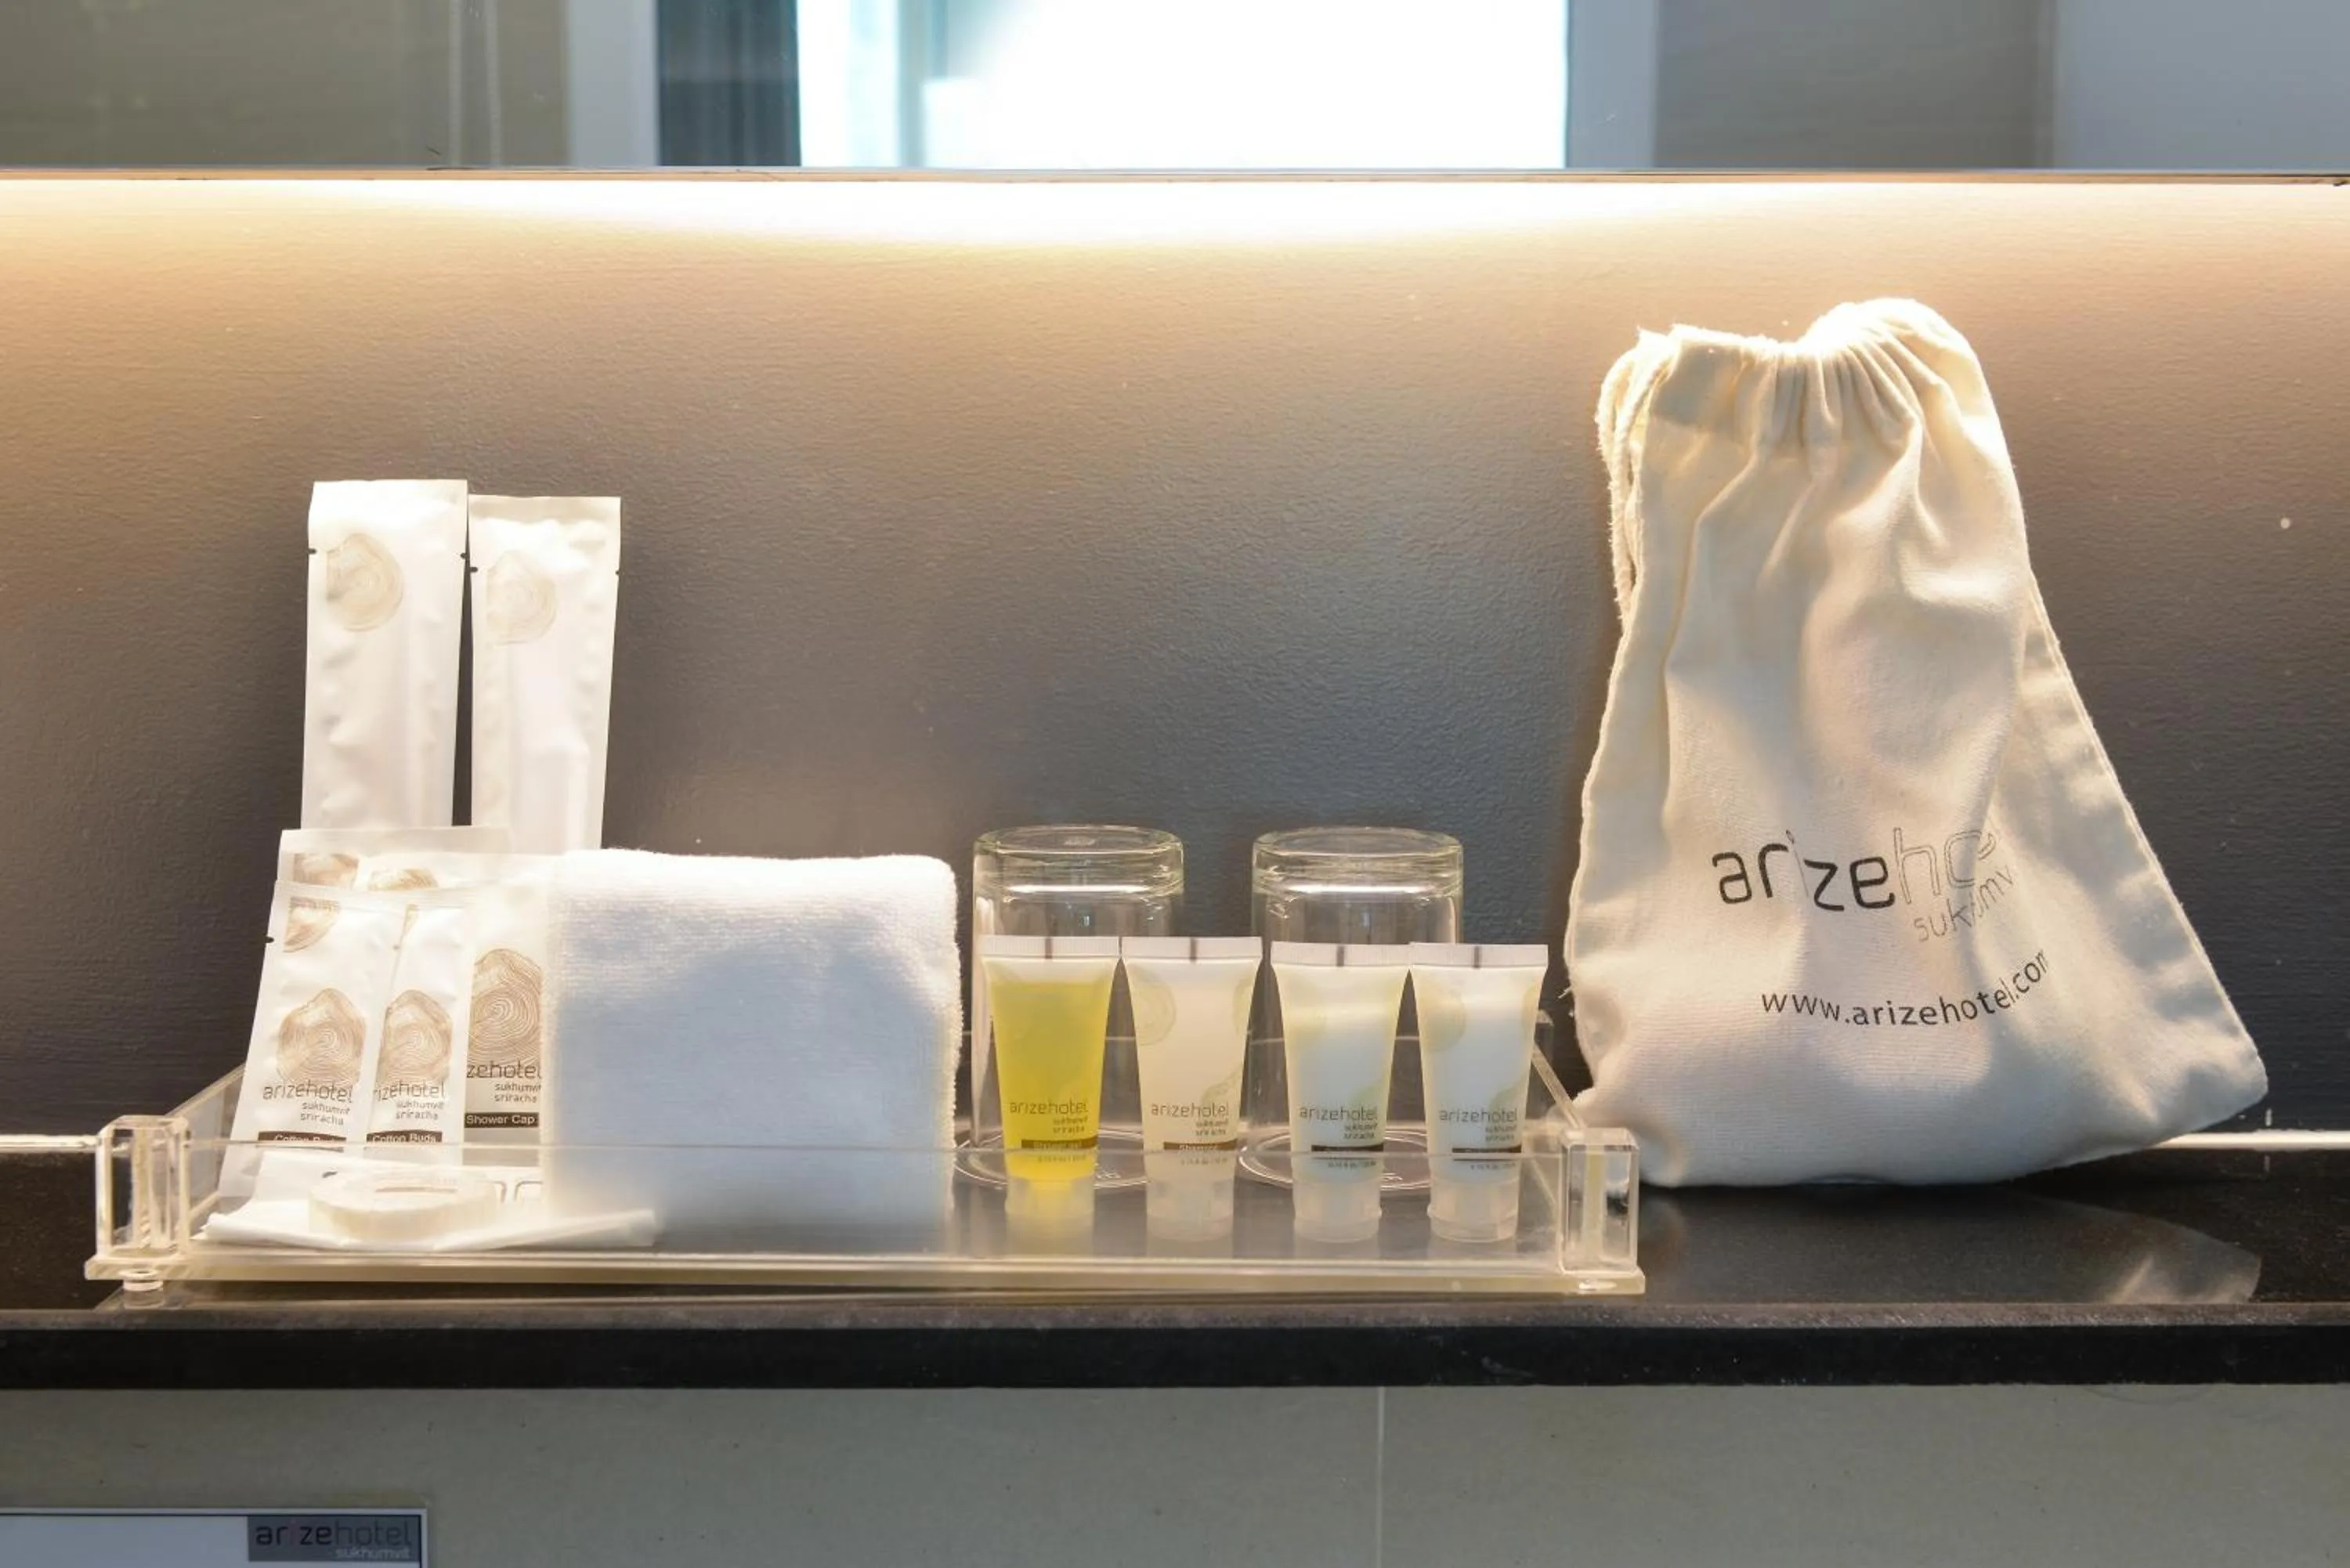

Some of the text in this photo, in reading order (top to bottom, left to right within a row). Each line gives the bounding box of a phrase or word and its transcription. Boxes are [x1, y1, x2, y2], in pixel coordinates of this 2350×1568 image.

[466, 1060, 542, 1079] zehotel
[262, 1079, 353, 1104] arizehotel
[1009, 1097, 1089, 1115] arizehotel
[1151, 1101, 1229, 1118] arizehotel
[1299, 1105, 1378, 1121] arizehotel
[1439, 1107, 1518, 1122] arizehotel
[466, 1115, 535, 1125] Shower Cap
